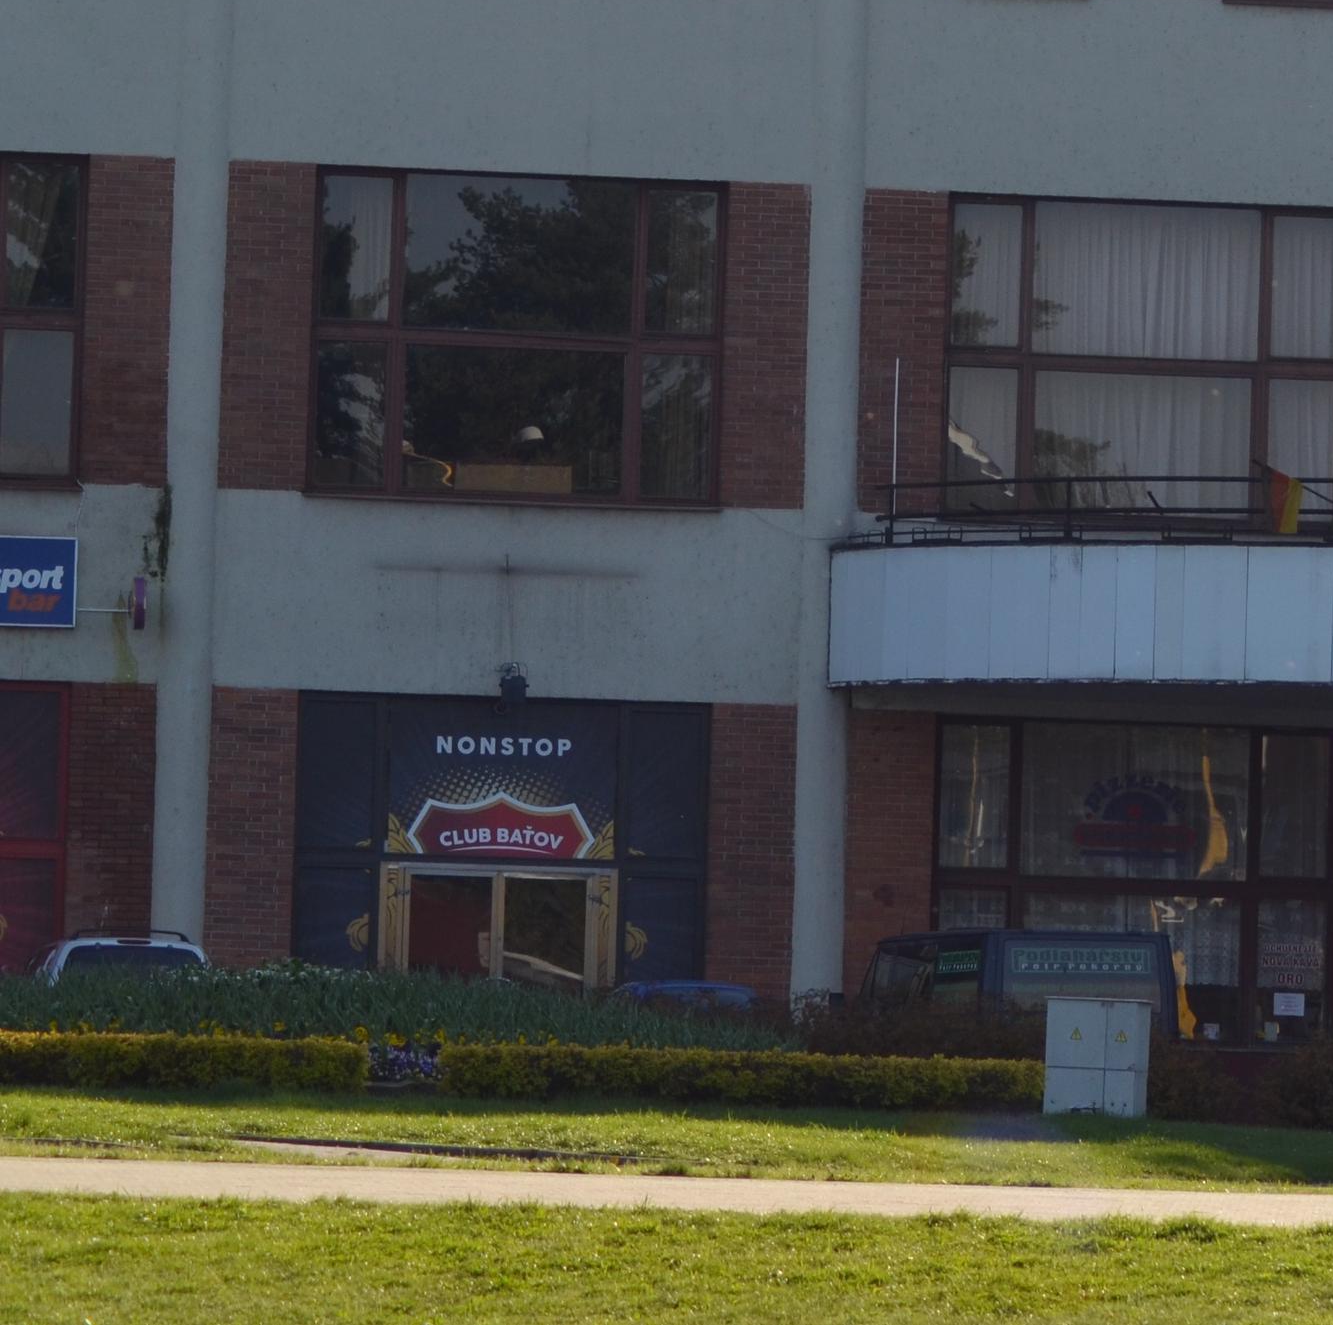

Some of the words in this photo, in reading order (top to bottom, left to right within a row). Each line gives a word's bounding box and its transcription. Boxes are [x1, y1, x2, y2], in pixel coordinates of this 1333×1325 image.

[0, 565, 64, 594] port
[8, 588, 62, 612] bar
[436, 735, 573, 756] NONSTOP
[439, 828, 491, 847] CLUB
[496, 825, 564, 850] BAŤOV
[1277, 972, 1304, 985] ORO
